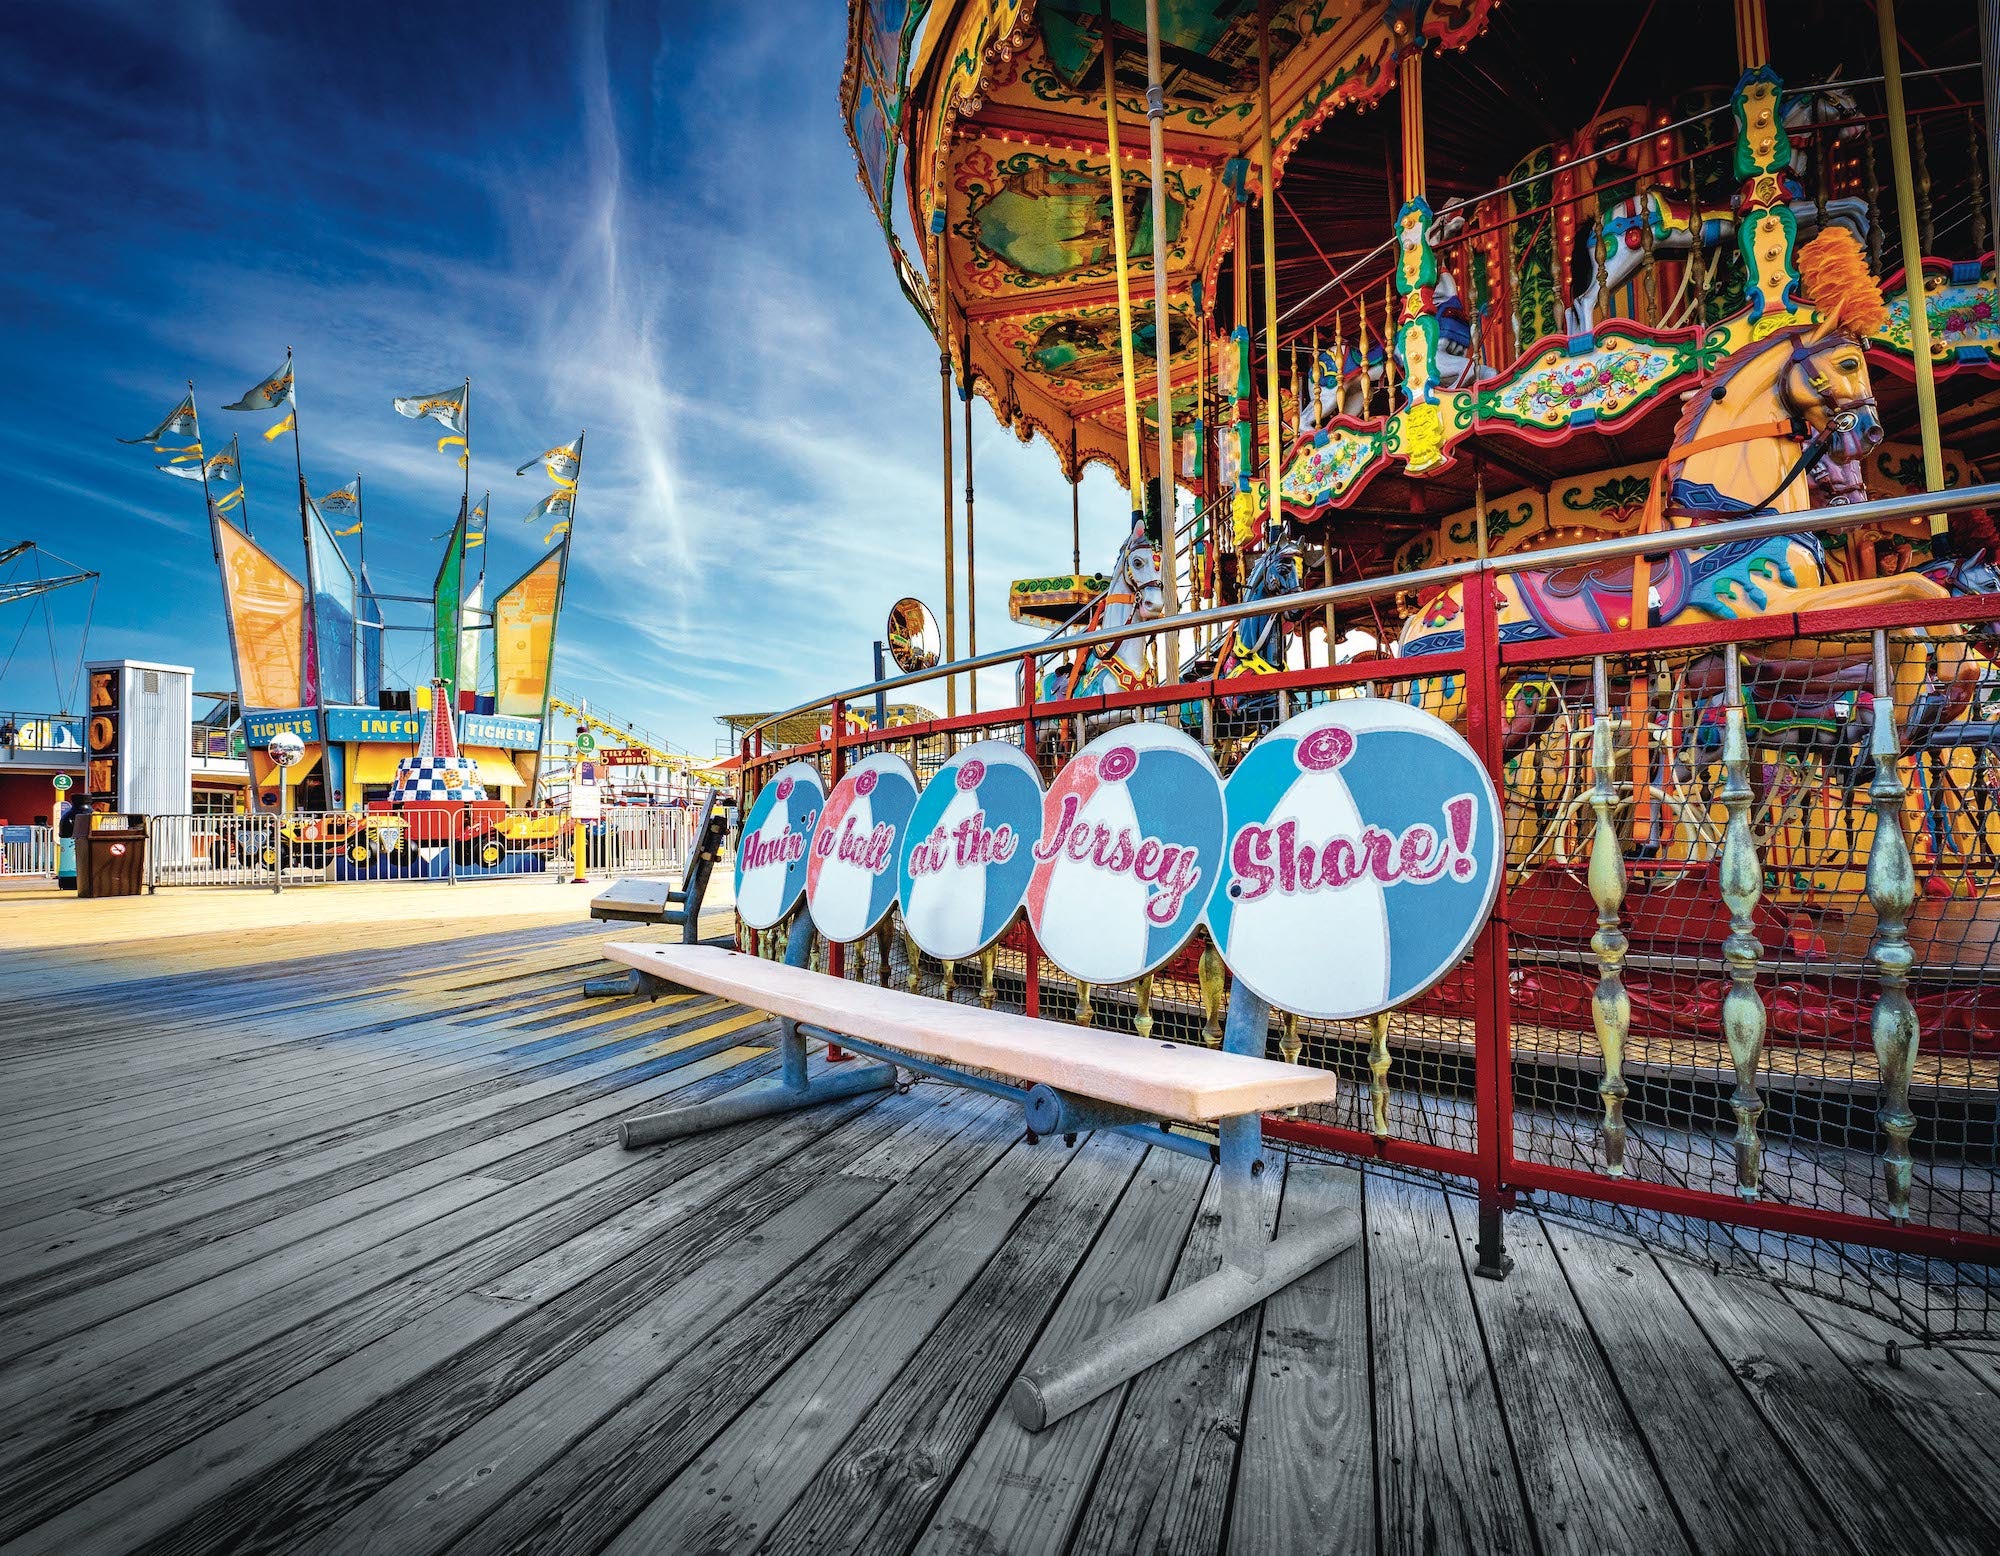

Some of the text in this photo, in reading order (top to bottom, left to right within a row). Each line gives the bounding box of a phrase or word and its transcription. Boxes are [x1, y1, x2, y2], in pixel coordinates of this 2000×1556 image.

[26, 729, 34, 740] 7
[252, 720, 312, 737] TICKETS
[361, 720, 419, 735] INFO
[467, 723, 536, 743] TICKETS
[582, 736, 590, 747] 3
[59, 777, 67, 785] 3
[742, 796, 1473, 923] Havin' a ball at the Jersey Shore!
